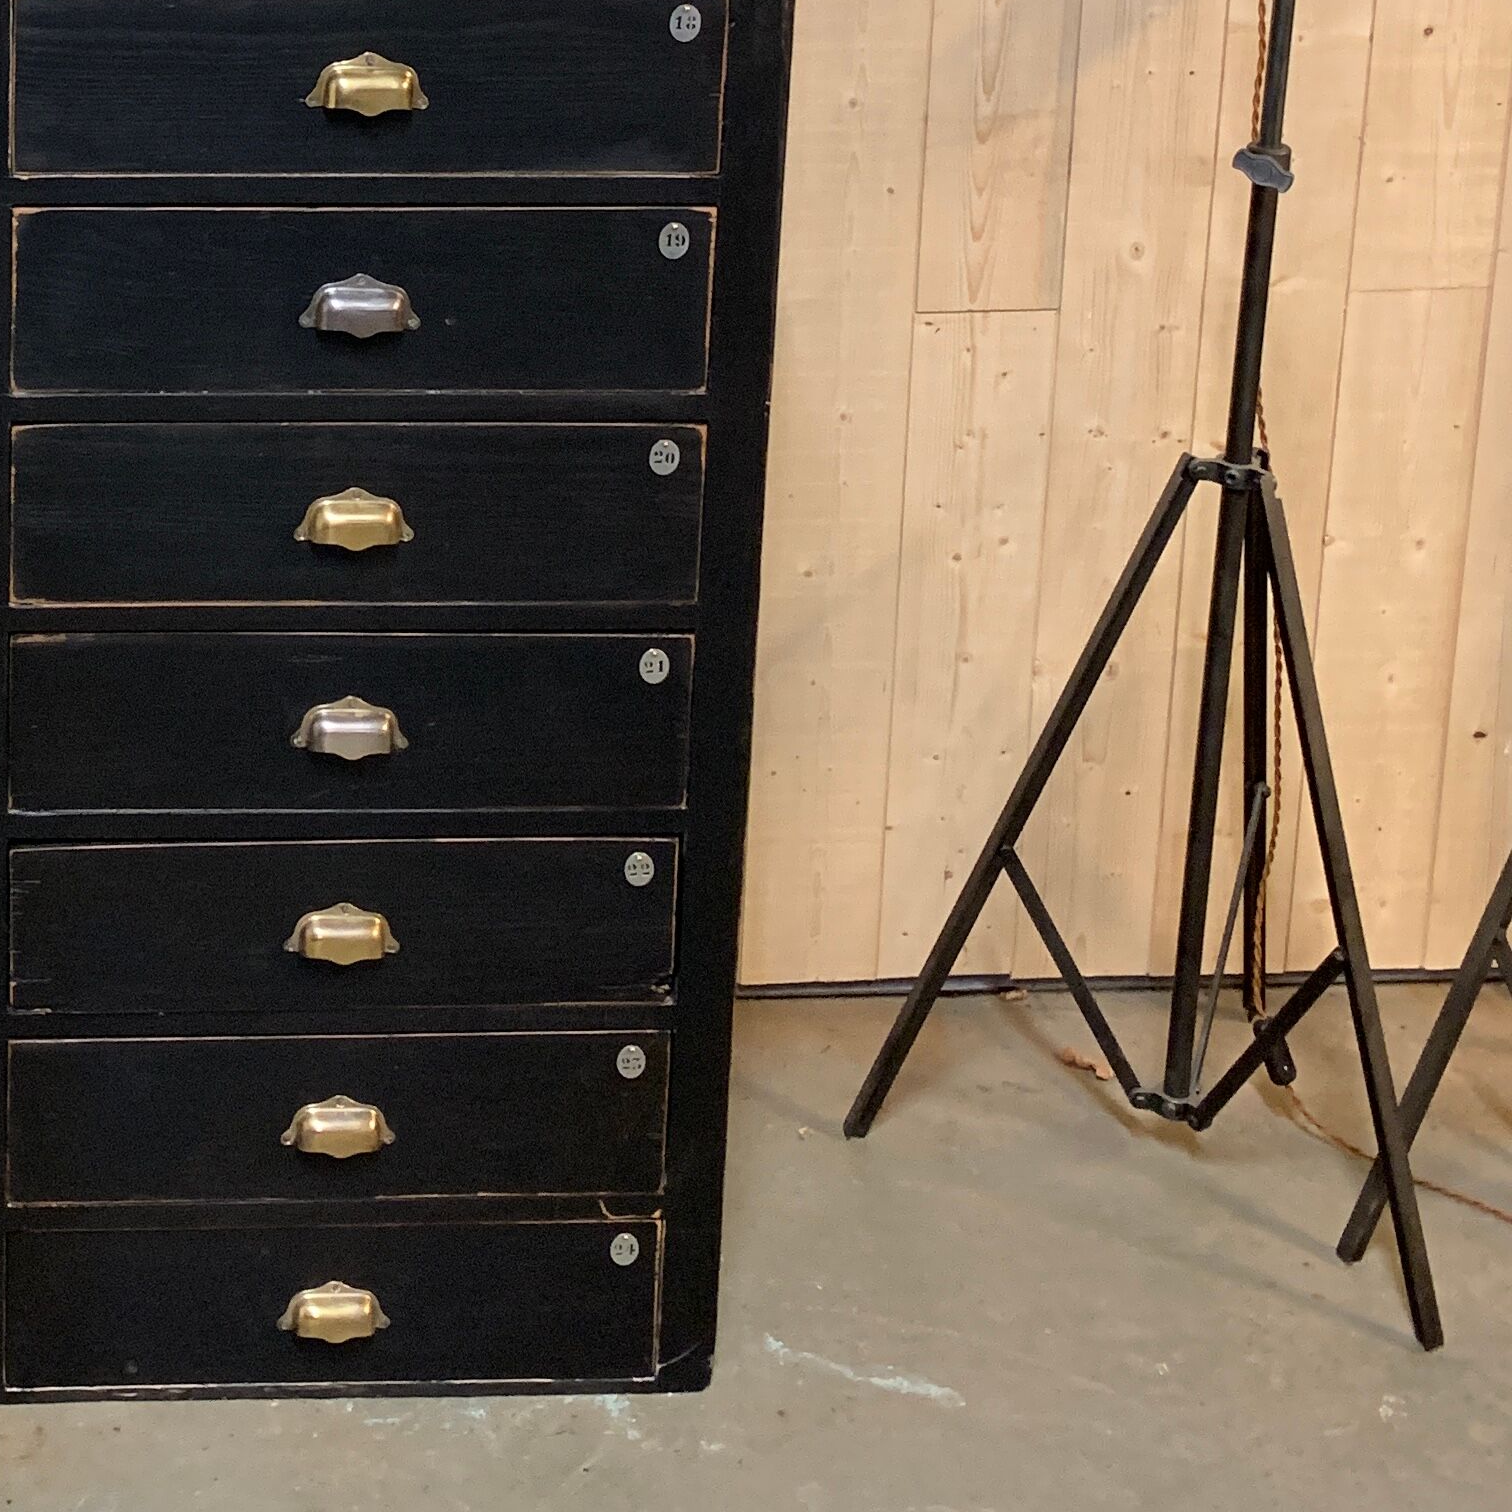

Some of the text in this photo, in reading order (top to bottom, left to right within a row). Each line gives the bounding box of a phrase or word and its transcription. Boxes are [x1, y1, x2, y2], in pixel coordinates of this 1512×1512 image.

[675, 15, 697, 30] 18
[666, 233, 686, 247] 19
[653, 450, 675, 464] 20
[644, 660, 664, 673] 21
